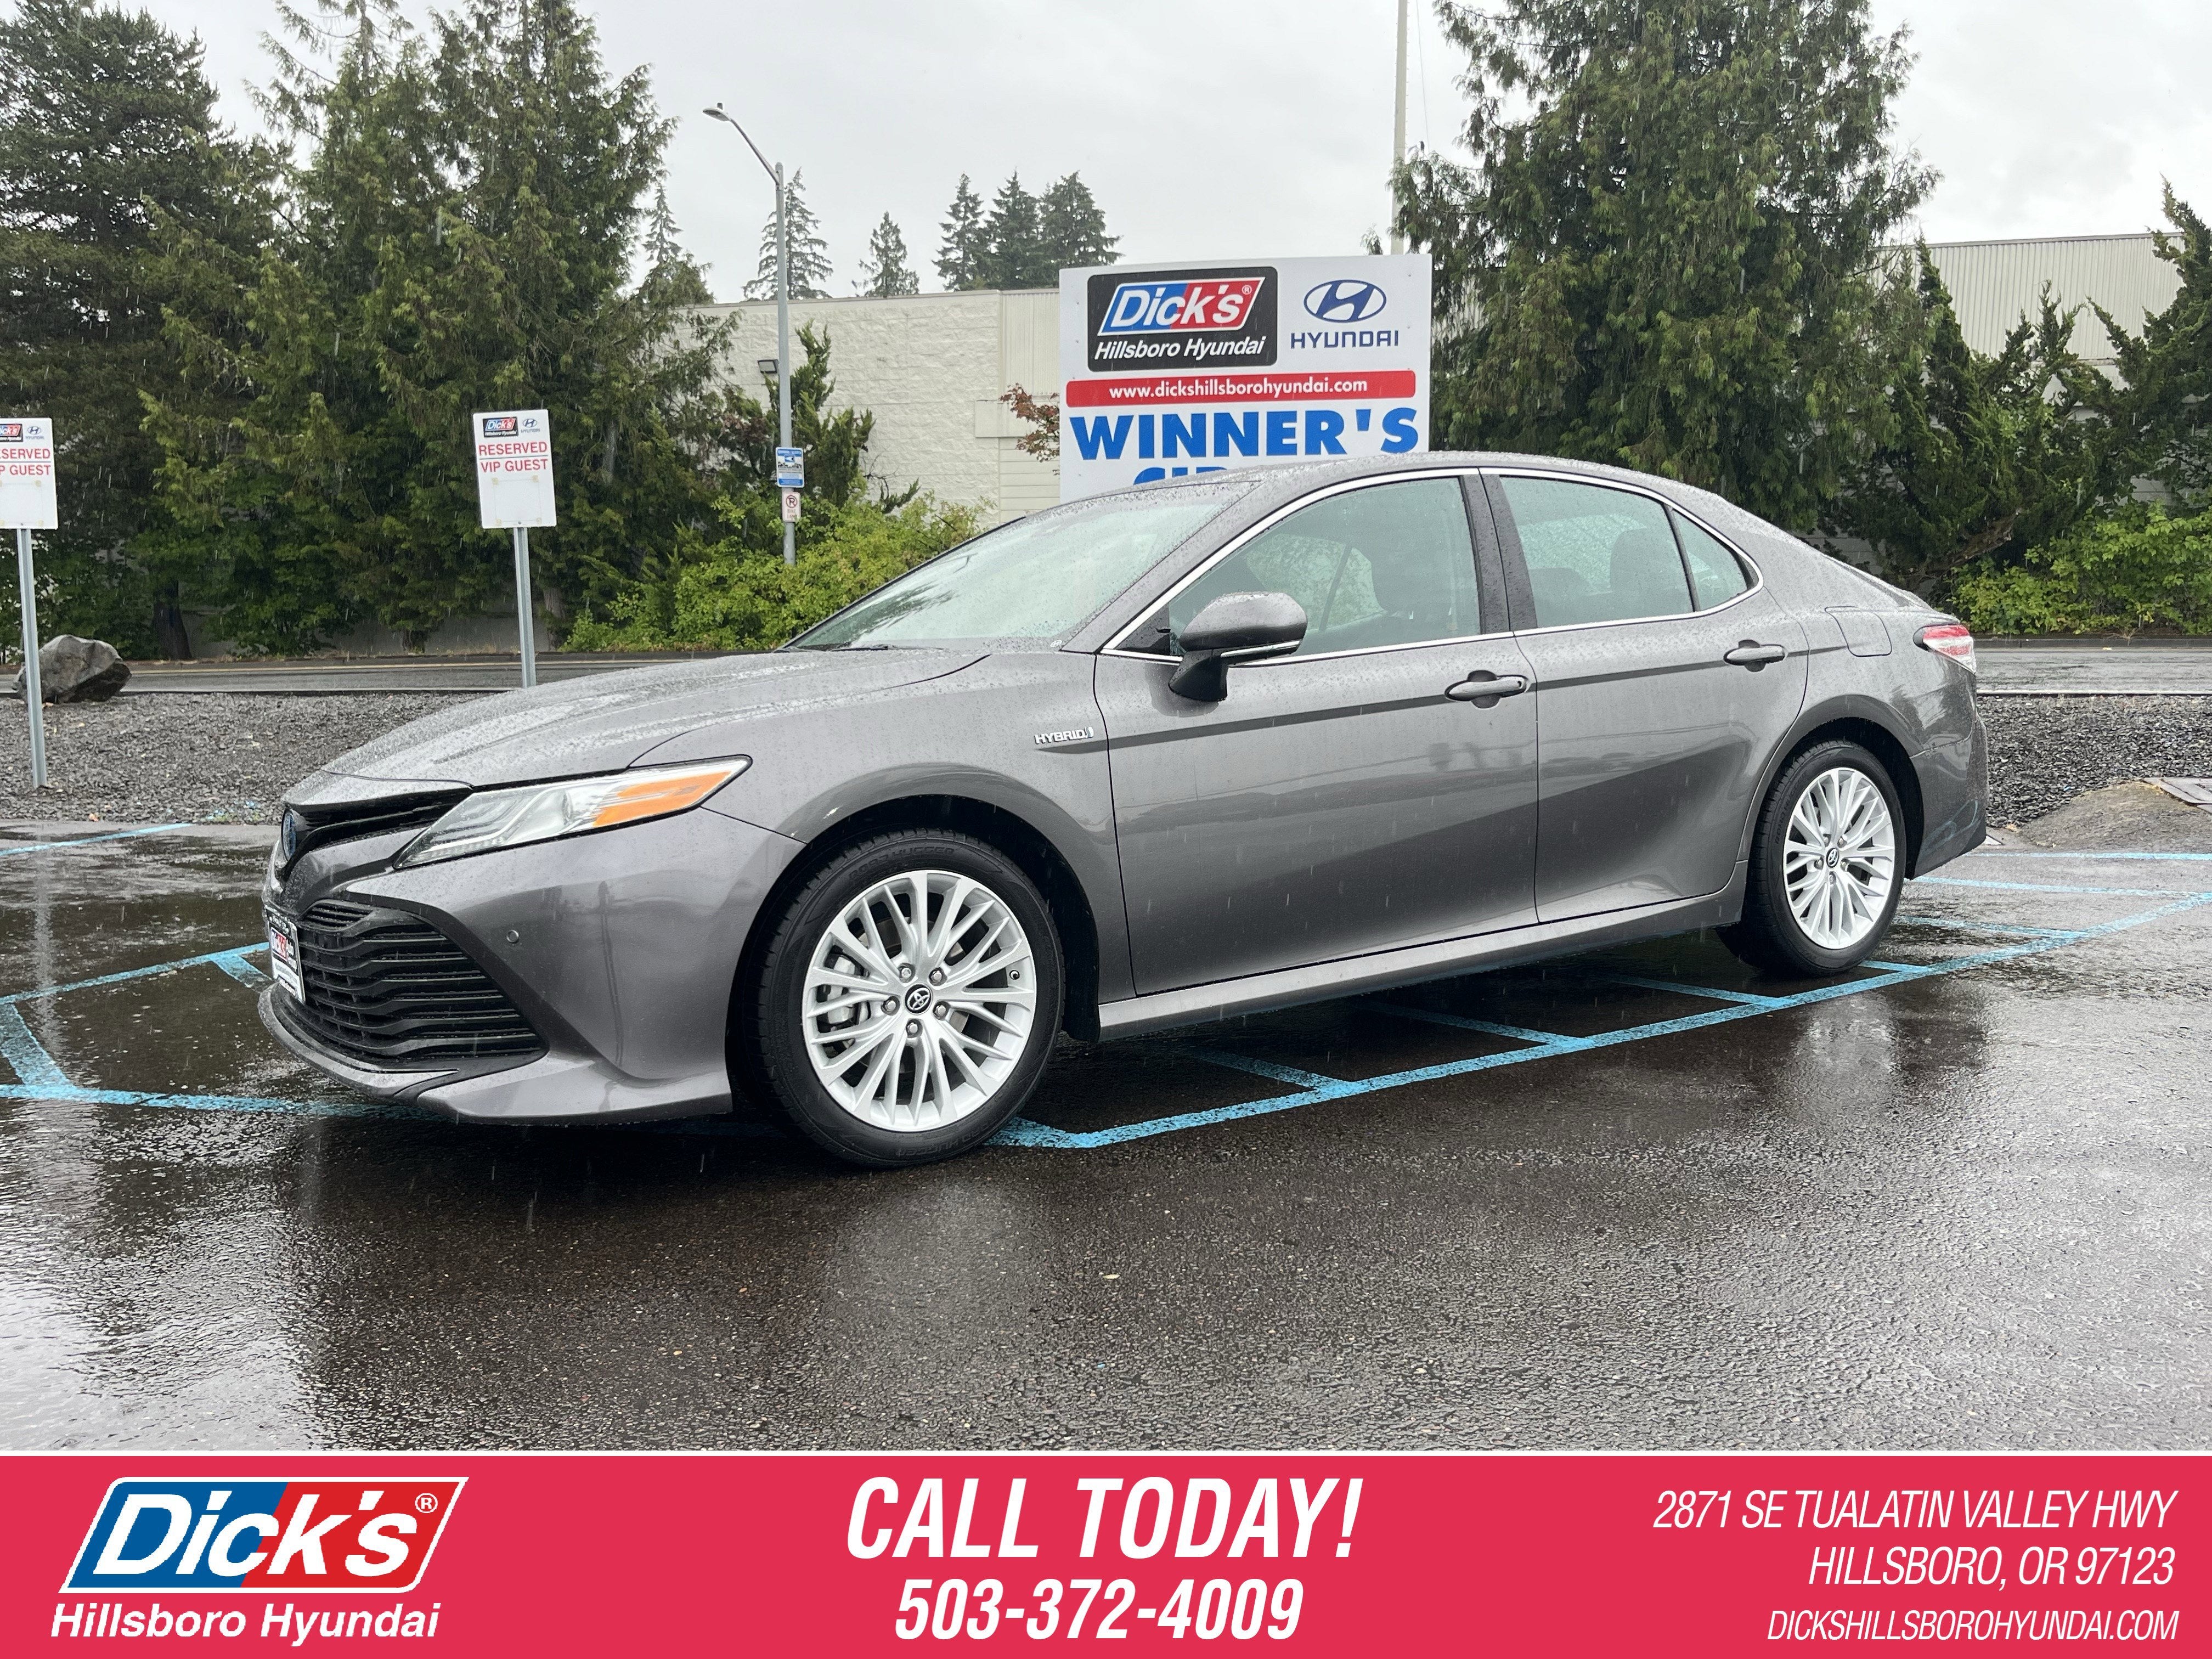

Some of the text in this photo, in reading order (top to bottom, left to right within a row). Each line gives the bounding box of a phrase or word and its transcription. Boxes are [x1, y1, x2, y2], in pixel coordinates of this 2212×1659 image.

[1110, 284, 1244, 328] Dick's
[1290, 330, 1399, 349] HYUNDAI
[1094, 336, 1267, 361] Hillsboro Hyundai
[1109, 377, 1368, 399] www.dickshillsborohyundai.com
[1069, 407, 1419, 460] WINNER'S
[0, 448, 50, 459] SERVED
[478, 442, 548, 456] RESERVED
[9, 465, 52, 475] GUEST
[481, 459, 548, 472] VIP GUEST
[1034, 729, 1087, 744] HYBRID
